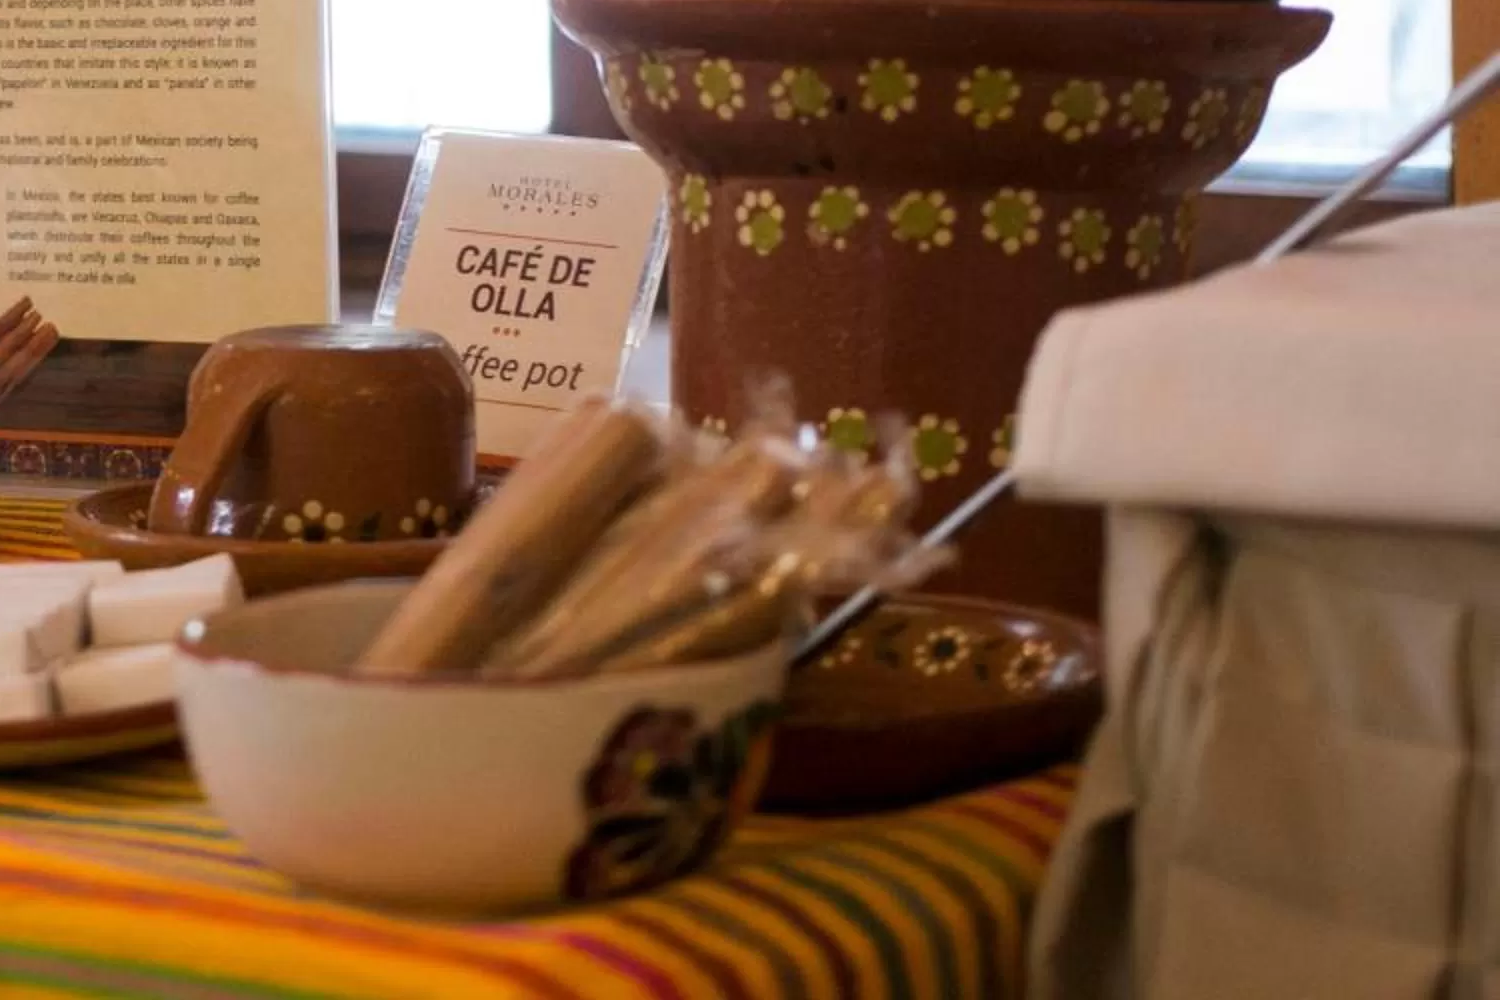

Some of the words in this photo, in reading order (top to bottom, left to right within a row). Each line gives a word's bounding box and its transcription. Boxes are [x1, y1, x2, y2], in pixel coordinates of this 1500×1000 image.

[487, 184, 597, 209] MORALES
[456, 245, 543, 281] CAFÉ
[550, 255, 596, 287] DE
[471, 283, 555, 320] OLLA
[462, 344, 518, 381] ffee
[521, 361, 584, 392] pot
